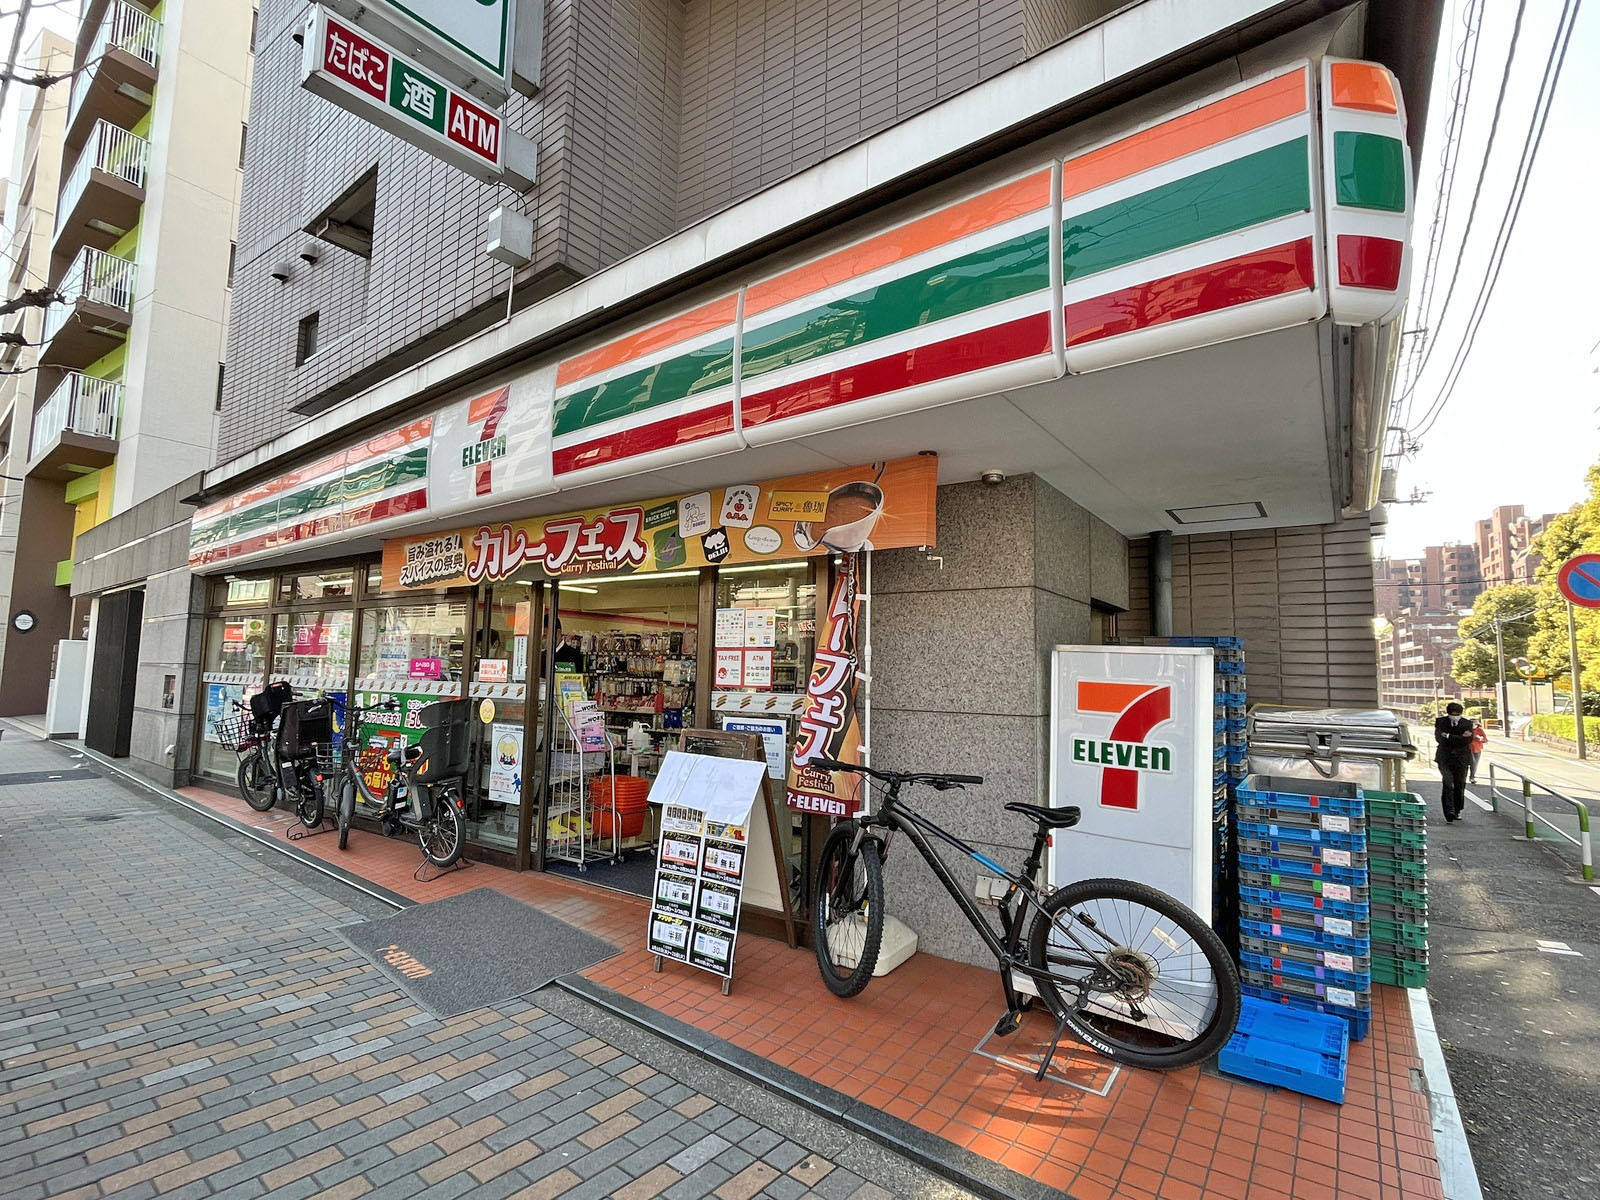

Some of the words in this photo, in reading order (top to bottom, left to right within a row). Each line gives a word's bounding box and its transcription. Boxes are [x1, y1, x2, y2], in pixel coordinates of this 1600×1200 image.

[327, 32, 384, 91] たばこ
[402, 72, 436, 120] 酒
[451, 105, 496, 154] ATM
[468, 513, 644, 579] カレーフェス
[401, 552, 463, 581] スパイスの祭典
[587, 559, 616, 572] Festival
[798, 777, 834, 793] Festival
[803, 767, 832, 784] Curry
